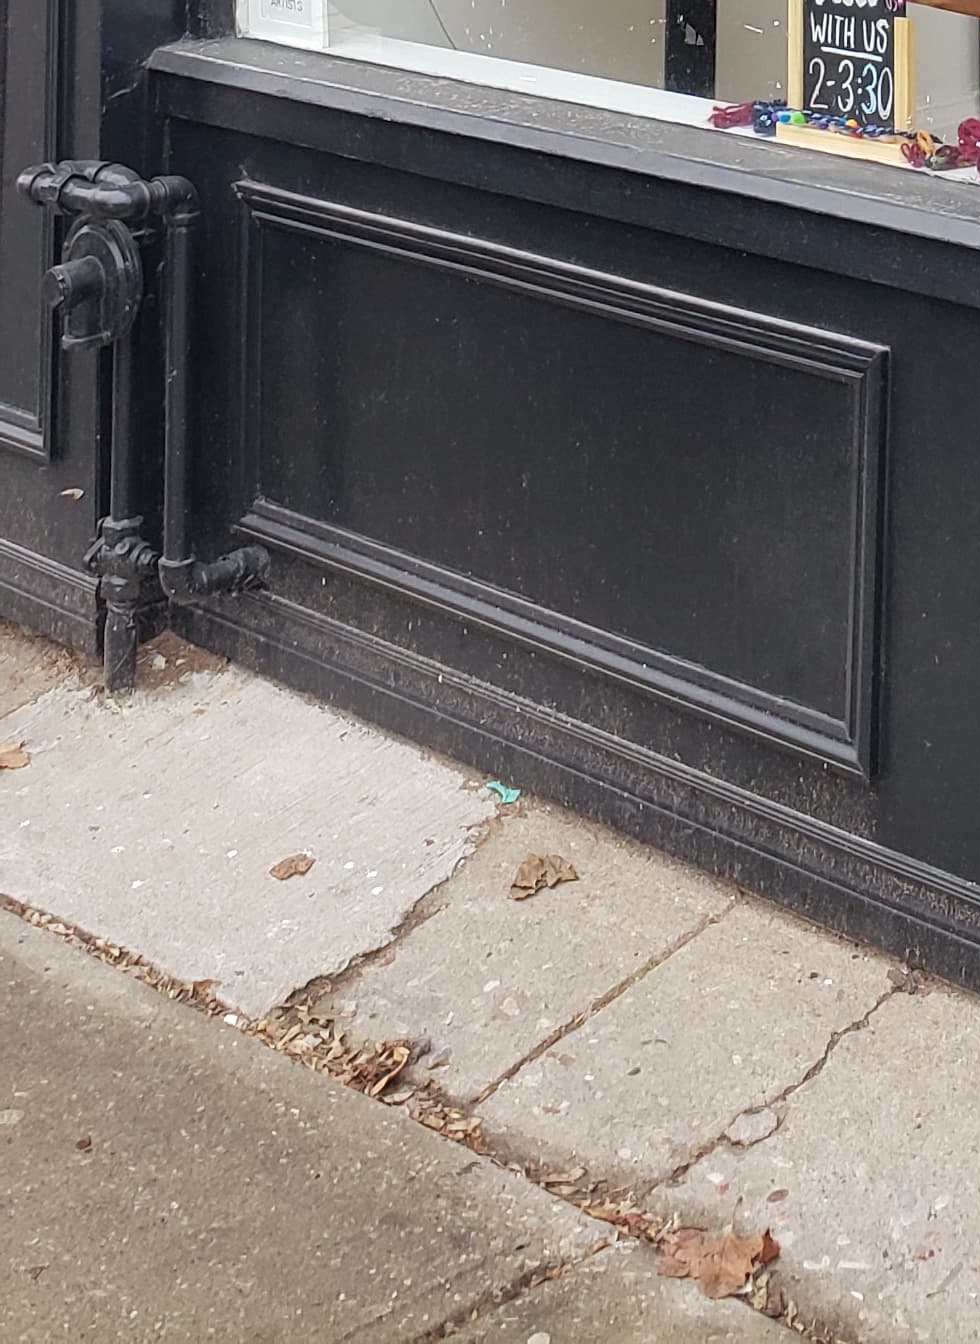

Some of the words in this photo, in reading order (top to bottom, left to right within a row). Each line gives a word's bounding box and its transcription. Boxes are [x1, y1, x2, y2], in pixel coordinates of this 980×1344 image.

[810, 12, 855, 50] WITH
[863, 18, 889, 54] US
[808, 57, 893, 120] 2-3:30
